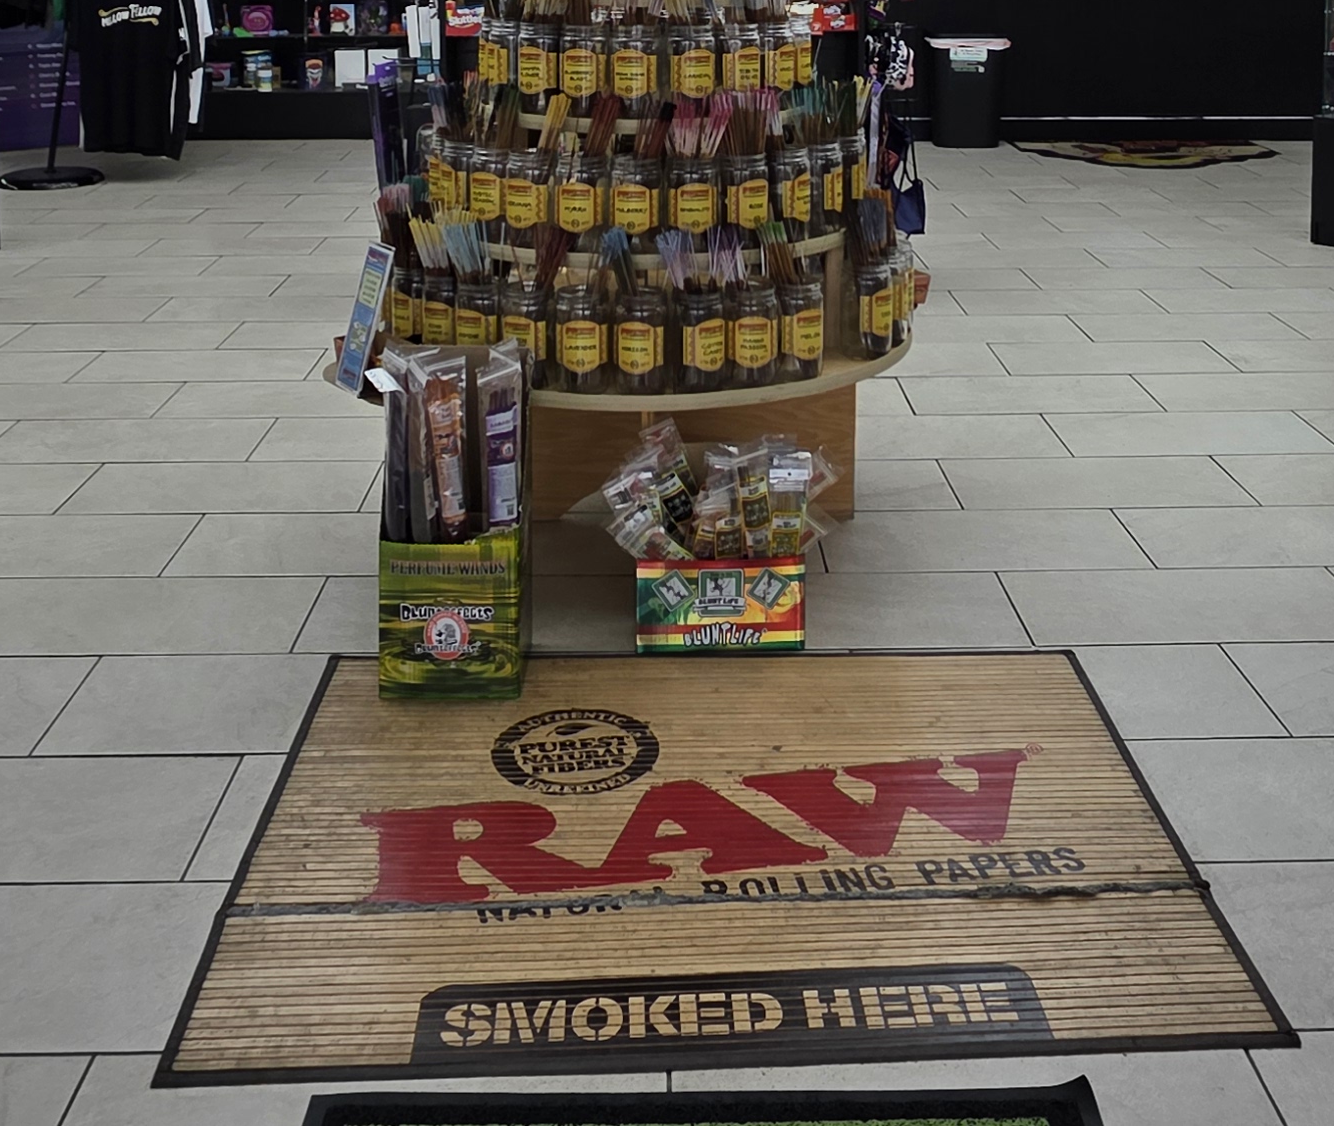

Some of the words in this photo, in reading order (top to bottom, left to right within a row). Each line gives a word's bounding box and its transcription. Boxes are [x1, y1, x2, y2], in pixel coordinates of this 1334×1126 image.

[390, 561, 456, 575] PERFUME
[458, 560, 506, 575] WANDS
[518, 710, 628, 733] AUTHENTIC
[519, 735, 631, 755] PUREST
[520, 747, 632, 766] NATURAL
[531, 758, 627, 775] FIBERS
[524, 772, 632, 793] UNREFINED
[359, 748, 1025, 905] RAW
[915, 846, 1086, 886] PAPERS
[439, 991, 784, 1047] SMOKED
[801, 981, 1020, 1031] HERE
